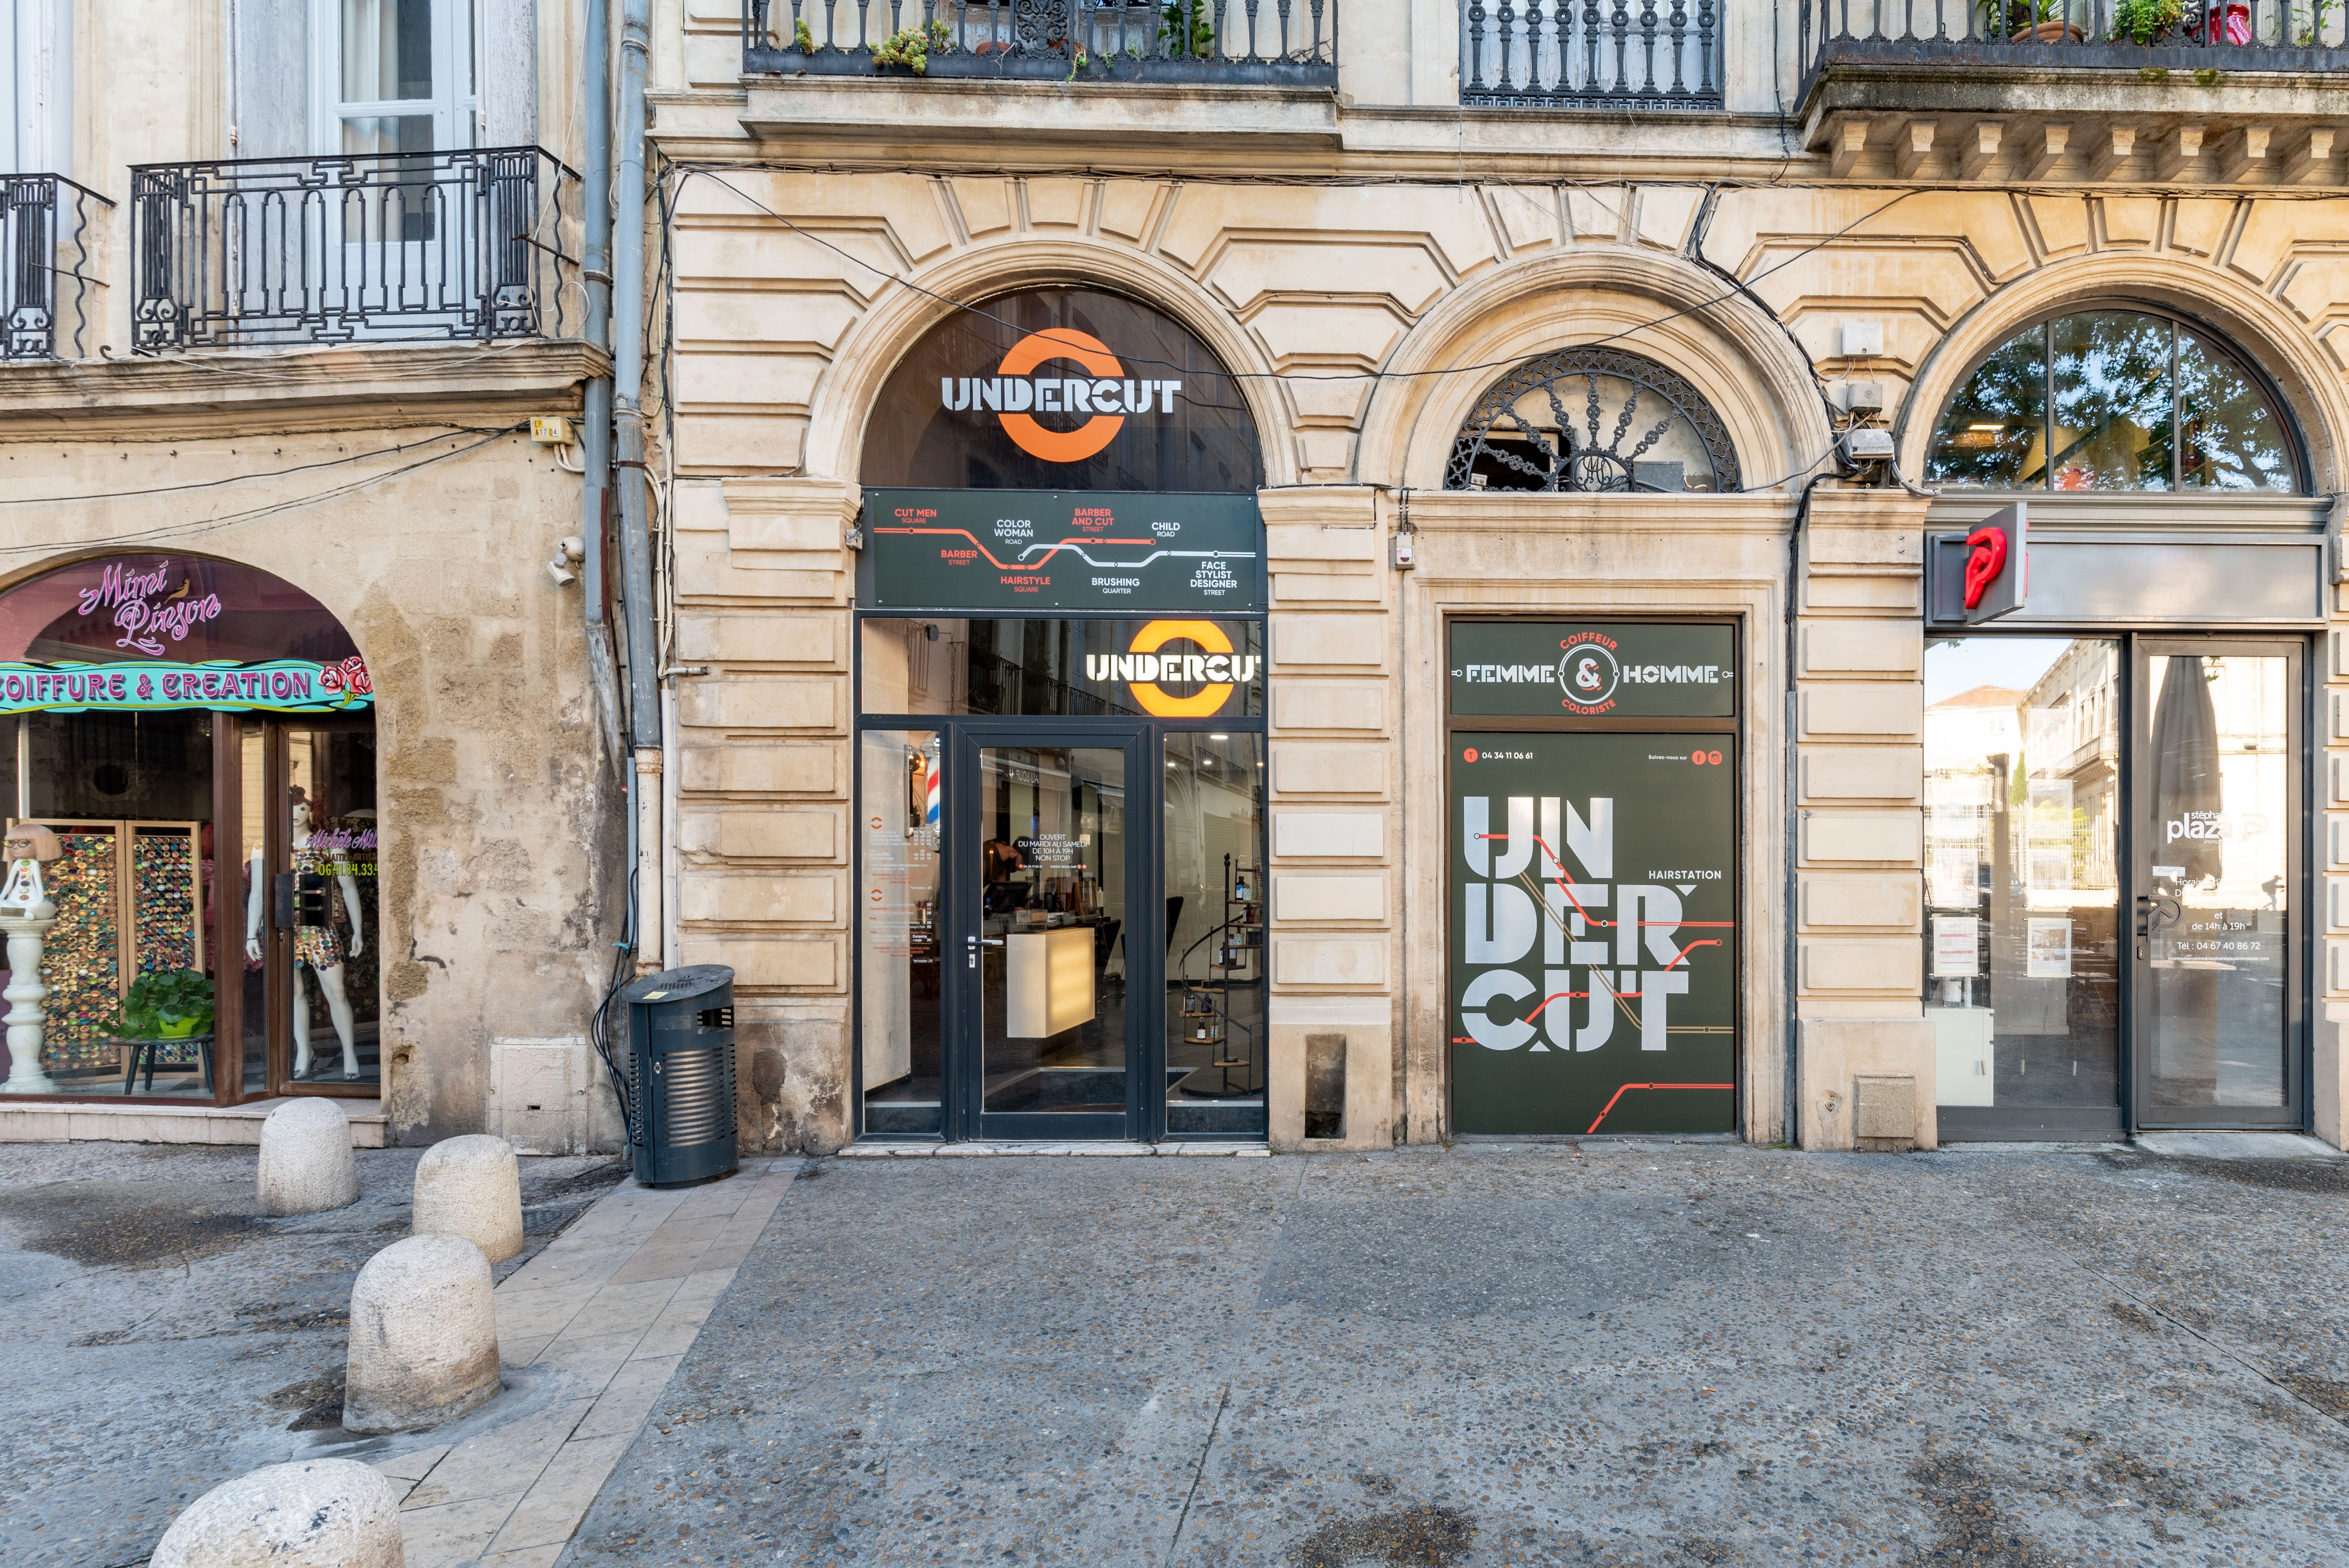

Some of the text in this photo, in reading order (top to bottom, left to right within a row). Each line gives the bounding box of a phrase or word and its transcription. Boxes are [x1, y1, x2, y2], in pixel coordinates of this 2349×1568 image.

[942, 378, 1181, 413] UNDERCUT
[895, 509, 914, 517] CUT
[997, 520, 1030, 528] COLOR
[1095, 517, 1114, 526] CUT
[994, 529, 1033, 537] WOMAN
[941, 550, 977, 558] BARBER
[1001, 576, 1050, 584] HAIRSTYLE
[1196, 570, 1232, 579] STYLIST
[78, 560, 169, 616] Mimi
[1092, 578, 1140, 586] BRUSHING
[1191, 579, 1237, 588] DESIGNER
[114, 593, 221, 655] Pinson
[1560, 632, 1617, 651] COIFFEUR
[1467, 658, 1718, 691] FEMME & HOMME
[0, 672, 311, 702] OIFFURE & CREATION
[1562, 699, 1616, 715] COLORISTE
[1464, 796, 1613, 879] UN
[1649, 871, 1721, 879] HAIRSTATION
[1465, 883, 1697, 966] DER
[1461, 969, 1689, 1052] CUT
